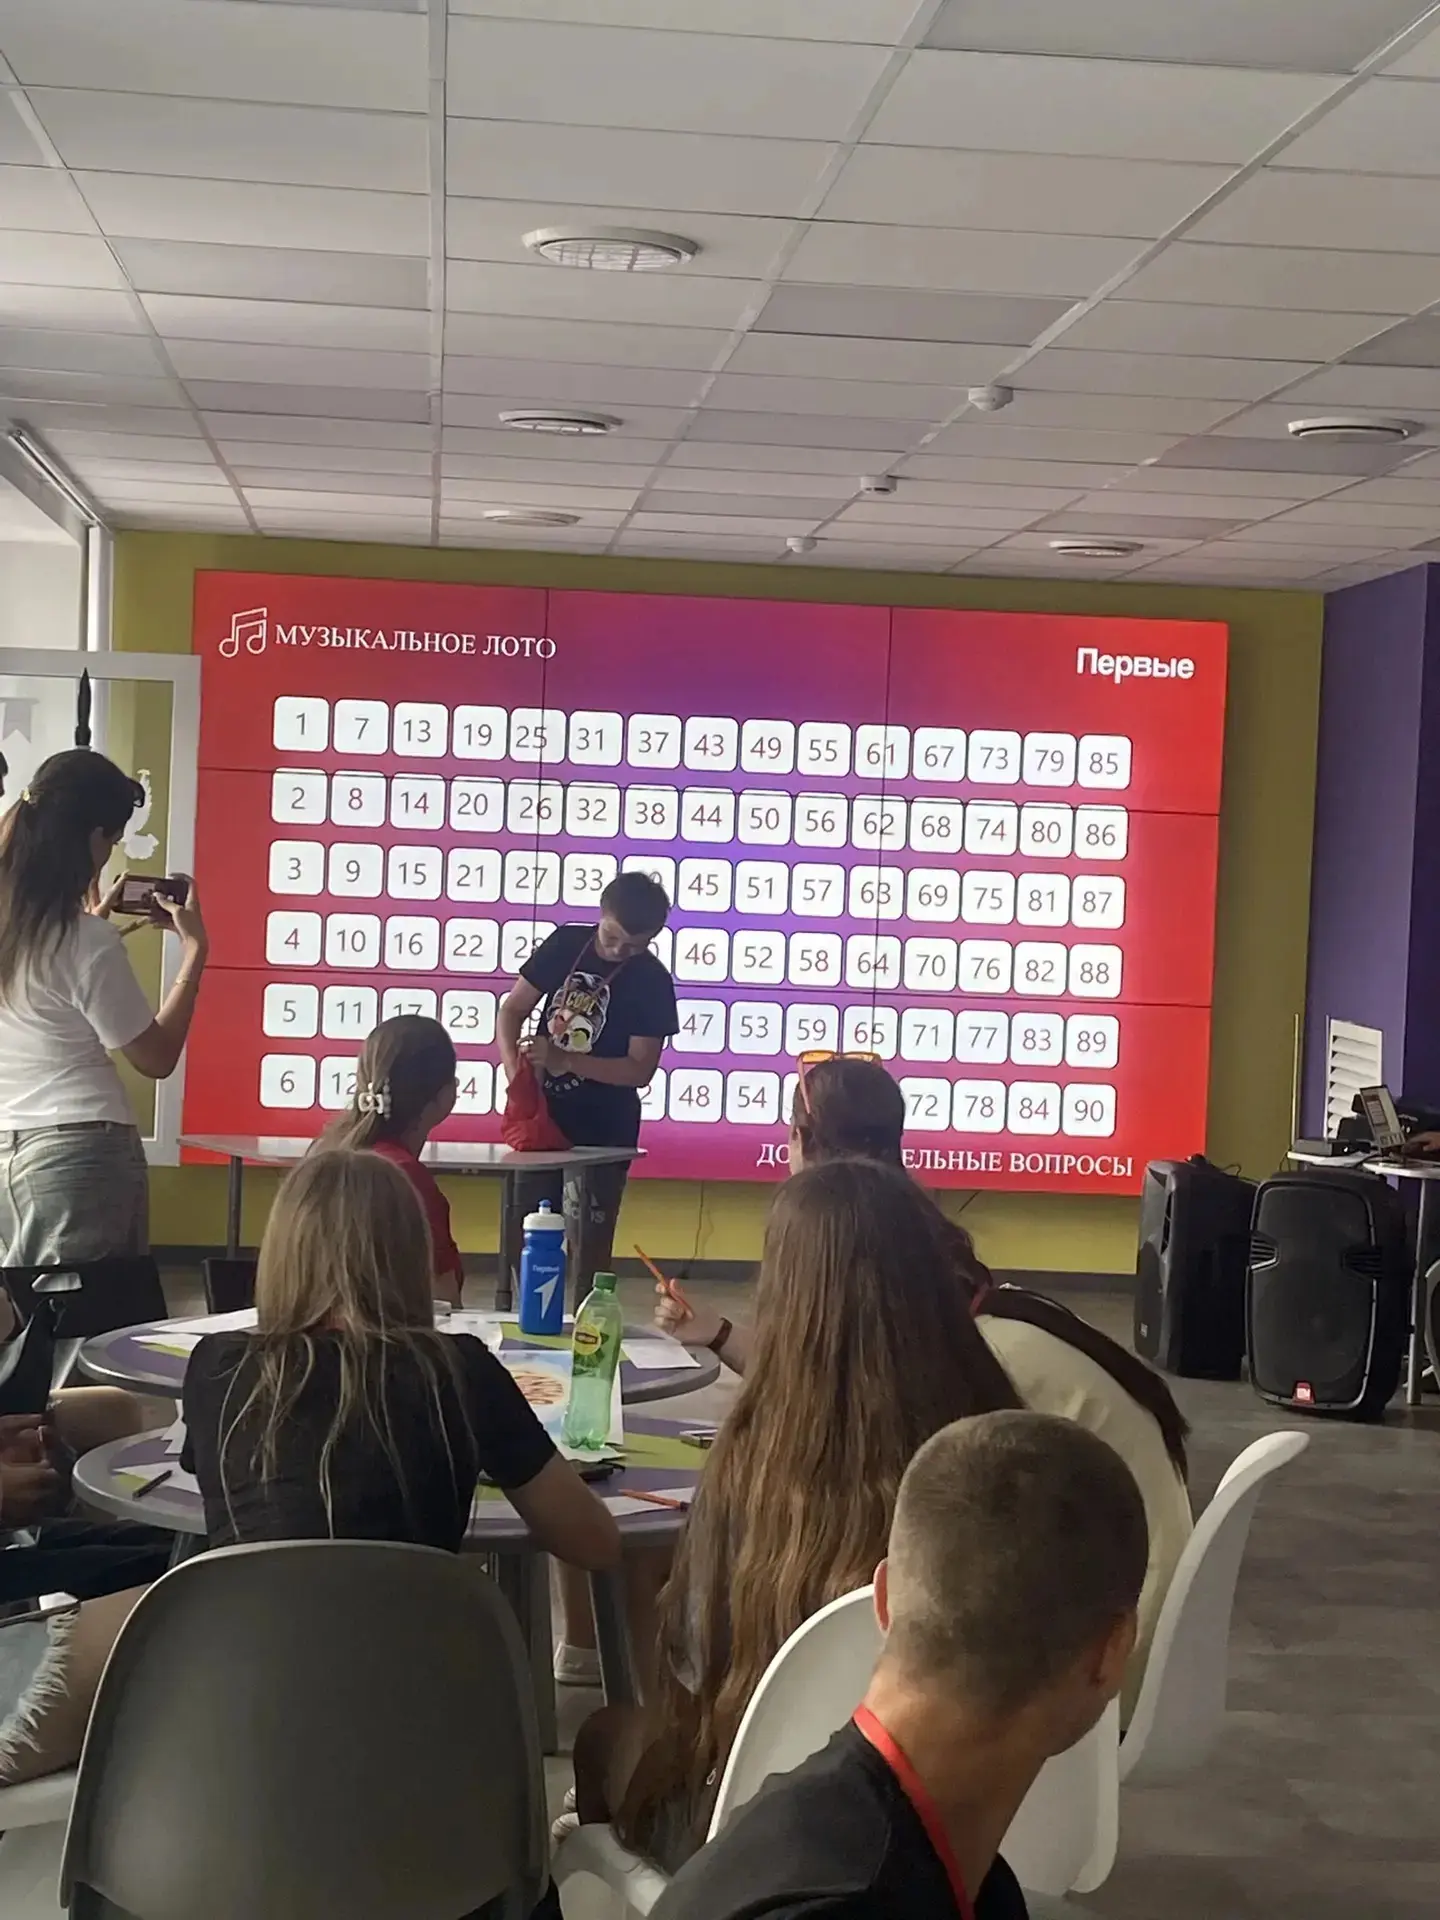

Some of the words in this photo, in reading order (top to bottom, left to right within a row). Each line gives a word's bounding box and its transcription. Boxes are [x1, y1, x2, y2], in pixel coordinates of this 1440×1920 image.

[275, 624, 476, 655] МУЗЫКАЛЬНОЕ
[483, 635, 556, 659] ЛОТО
[1077, 647, 1195, 684] Первые
[296, 712, 306, 736] 1
[354, 717, 370, 740] 7
[403, 718, 432, 744] 13
[463, 723, 493, 747] 19
[515, 725, 548, 749] 25
[575, 727, 604, 752] 31
[638, 730, 670, 754] 37
[693, 733, 725, 758] 43
[749, 736, 782, 760] 49
[808, 738, 838, 763] 55
[866, 742, 896, 766] 61
[924, 744, 955, 769] 67
[980, 746, 1009, 770] 73
[1034, 749, 1065, 773] 79
[1089, 751, 1119, 776] 85
[290, 786, 306, 810] 2
[347, 787, 364, 811] 8
[400, 791, 430, 815] 14
[457, 792, 489, 816] 20
[519, 796, 553, 821] 26
[576, 797, 607, 822] 32
[634, 801, 666, 826] 38
[690, 804, 723, 828] 44
[749, 807, 780, 831] 50
[805, 809, 836, 833] 56
[863, 811, 895, 837] 62
[921, 815, 951, 838] 68
[976, 818, 1007, 842] 74
[1030, 820, 1062, 845] 80
[1085, 823, 1116, 847] 86
[287, 857, 302, 881] 3
[345, 859, 361, 883] 9
[398, 861, 427, 886] 15
[456, 863, 484, 888] 21
[515, 866, 549, 890] 27
[573, 867, 603, 892] 33
[687, 872, 719, 897] 45
[747, 876, 773, 900] 51
[802, 878, 833, 902] 57
[860, 880, 892, 906] 63
[918, 883, 948, 908] 69
[973, 886, 1003, 911] 75
[1027, 889, 1055, 913] 81
[1082, 890, 1113, 914] 87
[283, 927, 301, 951] 4
[336, 928, 366, 953] 10
[393, 931, 424, 956] 16
[452, 933, 484, 958] 22
[684, 942, 717, 966] 46
[743, 945, 773, 969] 52
[799, 949, 829, 973] 58
[857, 951, 890, 976] 64
[916, 953, 946, 977] 70
[970, 957, 1001, 981] 76
[1024, 959, 1055, 983] 82
[1079, 961, 1110, 985] 88
[282, 999, 297, 1023] 5
[336, 1000, 362, 1025] 11
[448, 1005, 480, 1029] 23
[681, 1013, 714, 1037] 47
[740, 1015, 769, 1039] 53
[797, 1018, 827, 1042] 59
[853, 1021, 886, 1046] 65
[912, 1023, 939, 1047] 71
[968, 1026, 998, 1049] 77
[1022, 1028, 1052, 1052] 83
[1076, 1030, 1107, 1054] 89
[280, 1070, 295, 1094] 6
[332, 1072, 356, 1095] 12
[456, 1076, 478, 1100] 4
[678, 1084, 710, 1108] 48
[737, 1085, 768, 1109] 54
[909, 1093, 938, 1117] 72
[964, 1094, 995, 1119] 78
[1018, 1096, 1050, 1121] 84
[1074, 1099, 1105, 1123] 90
[1009, 1152, 1133, 1177] ВОПРОСЫ
